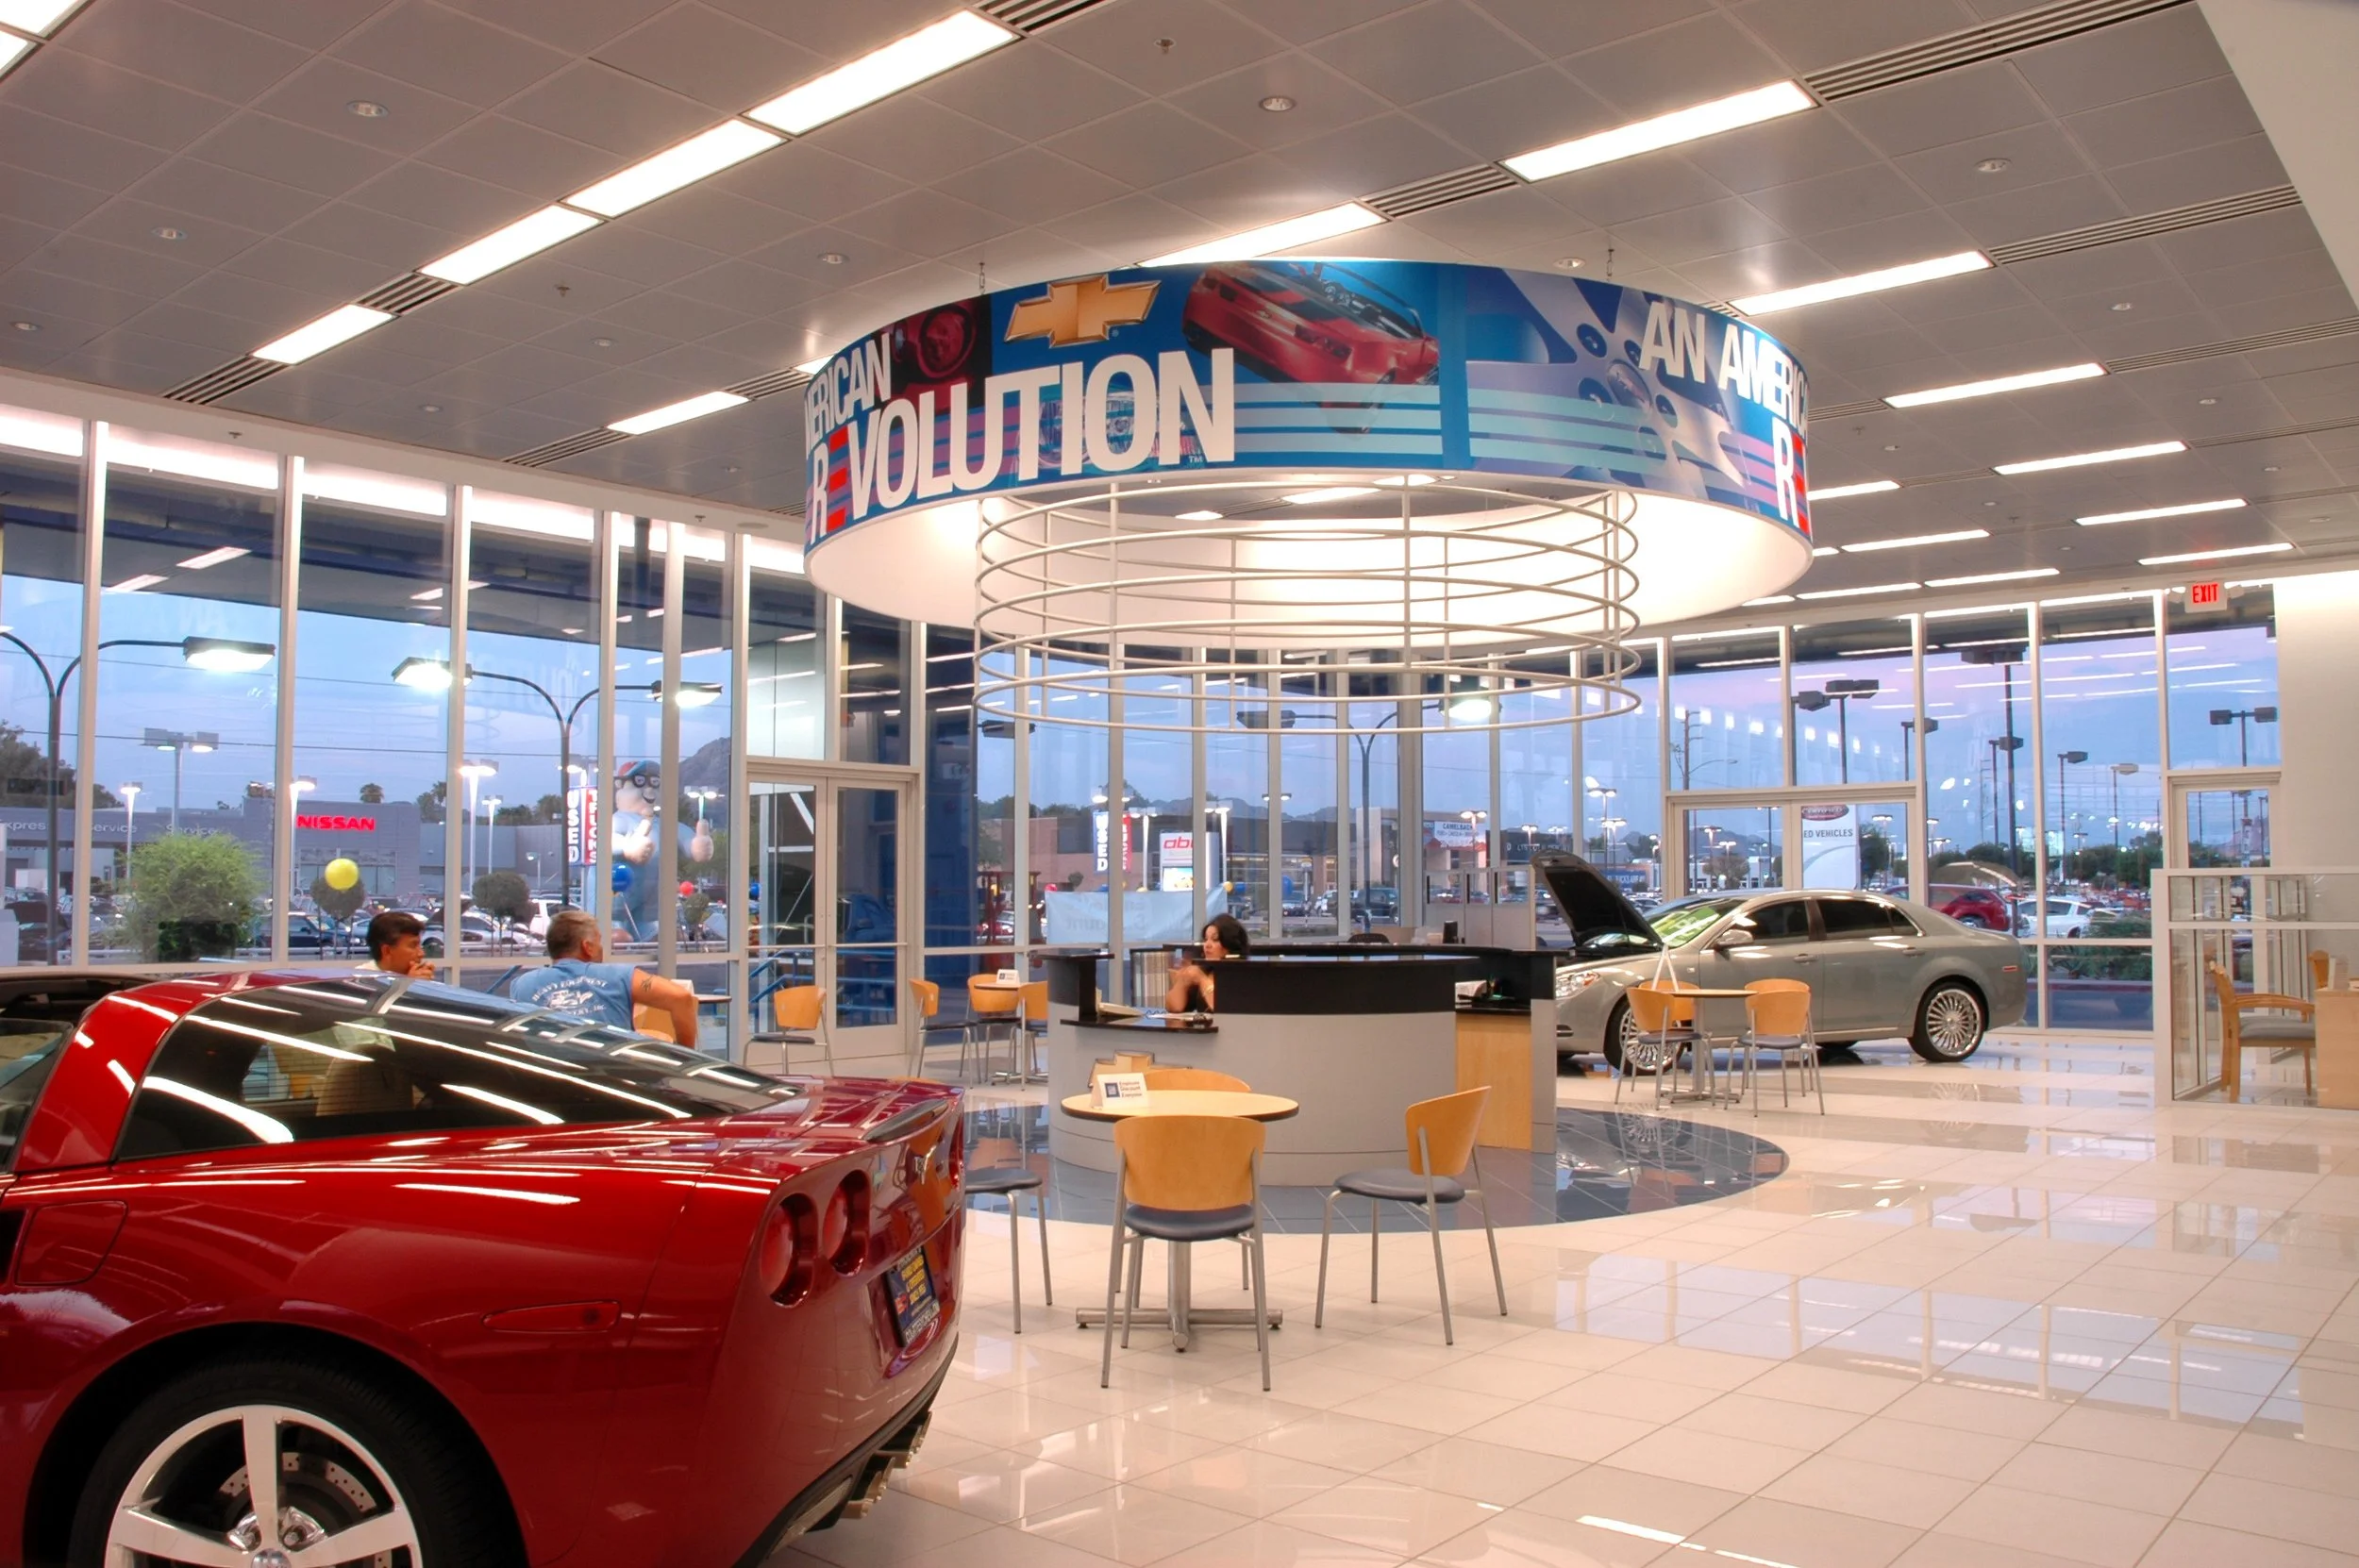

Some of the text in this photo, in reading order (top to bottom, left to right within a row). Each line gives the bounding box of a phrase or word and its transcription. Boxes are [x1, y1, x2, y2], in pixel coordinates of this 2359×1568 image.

[804, 332, 892, 460] ERICAN
[1639, 301, 1808, 447] AN AMERIC
[810, 348, 1234, 545] REVOLUTION
[1772, 417, 1814, 544] RE
[2192, 583, 2218, 604] EXIT
[296, 815, 376, 831] NISSAN
[566, 789, 579, 863] USED
[1096, 815, 1109, 872] USED
[1815, 828, 1854, 838] VEHICLES
